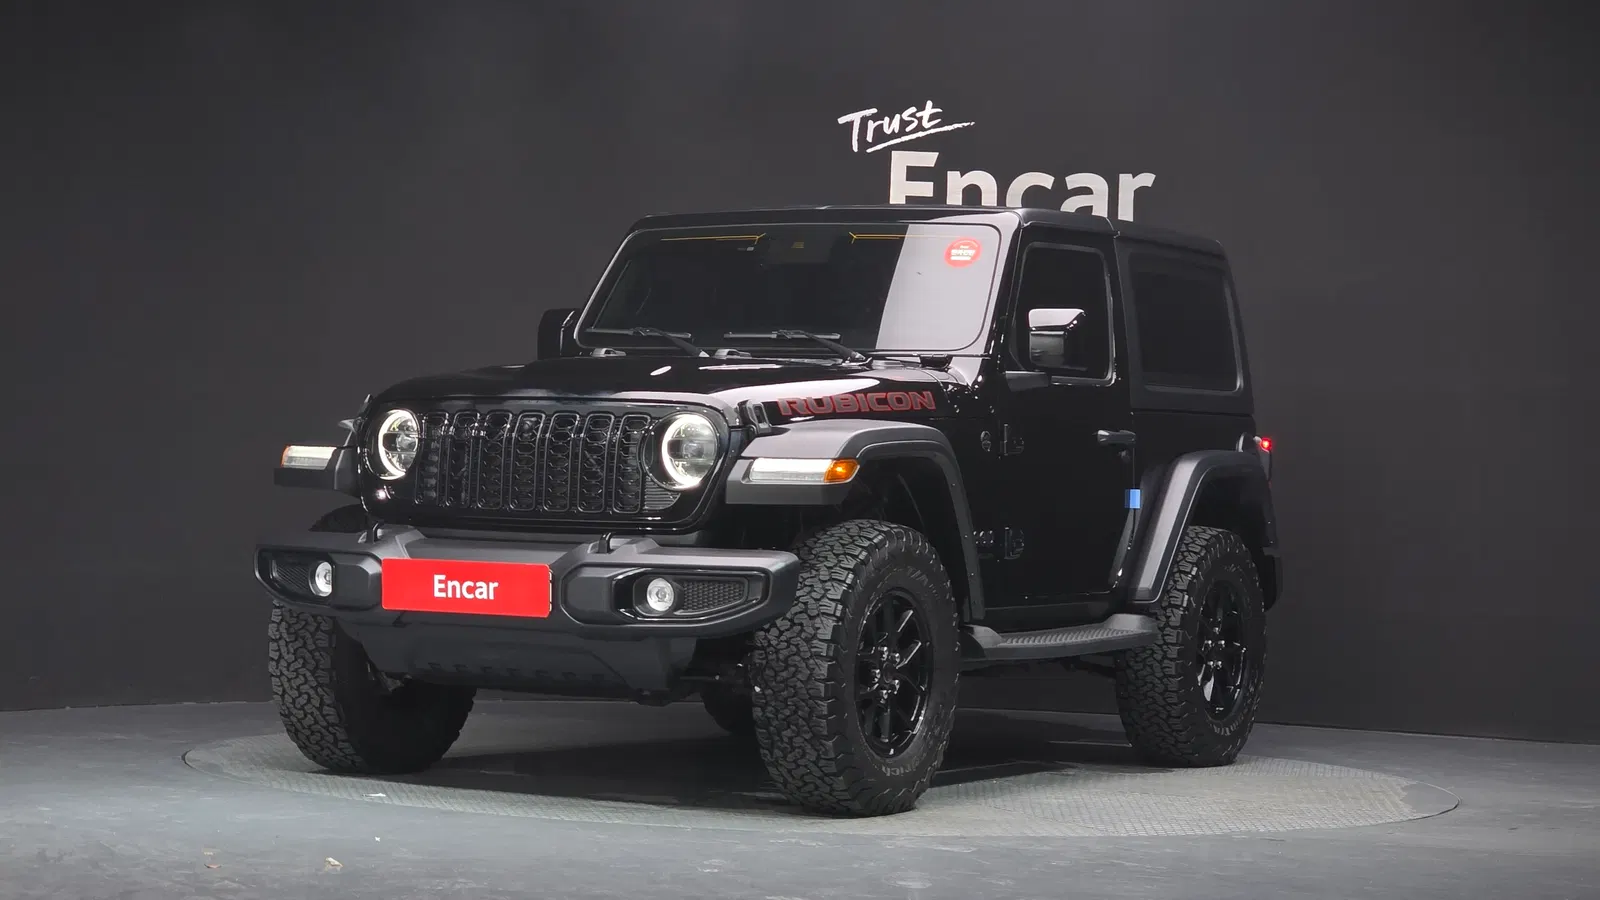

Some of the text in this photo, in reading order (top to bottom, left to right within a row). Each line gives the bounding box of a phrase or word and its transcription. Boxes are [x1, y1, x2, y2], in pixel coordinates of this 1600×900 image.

[837, 99, 944, 153] Trust
[778, 390, 937, 416] RUBICON
[433, 574, 499, 600] Encar
